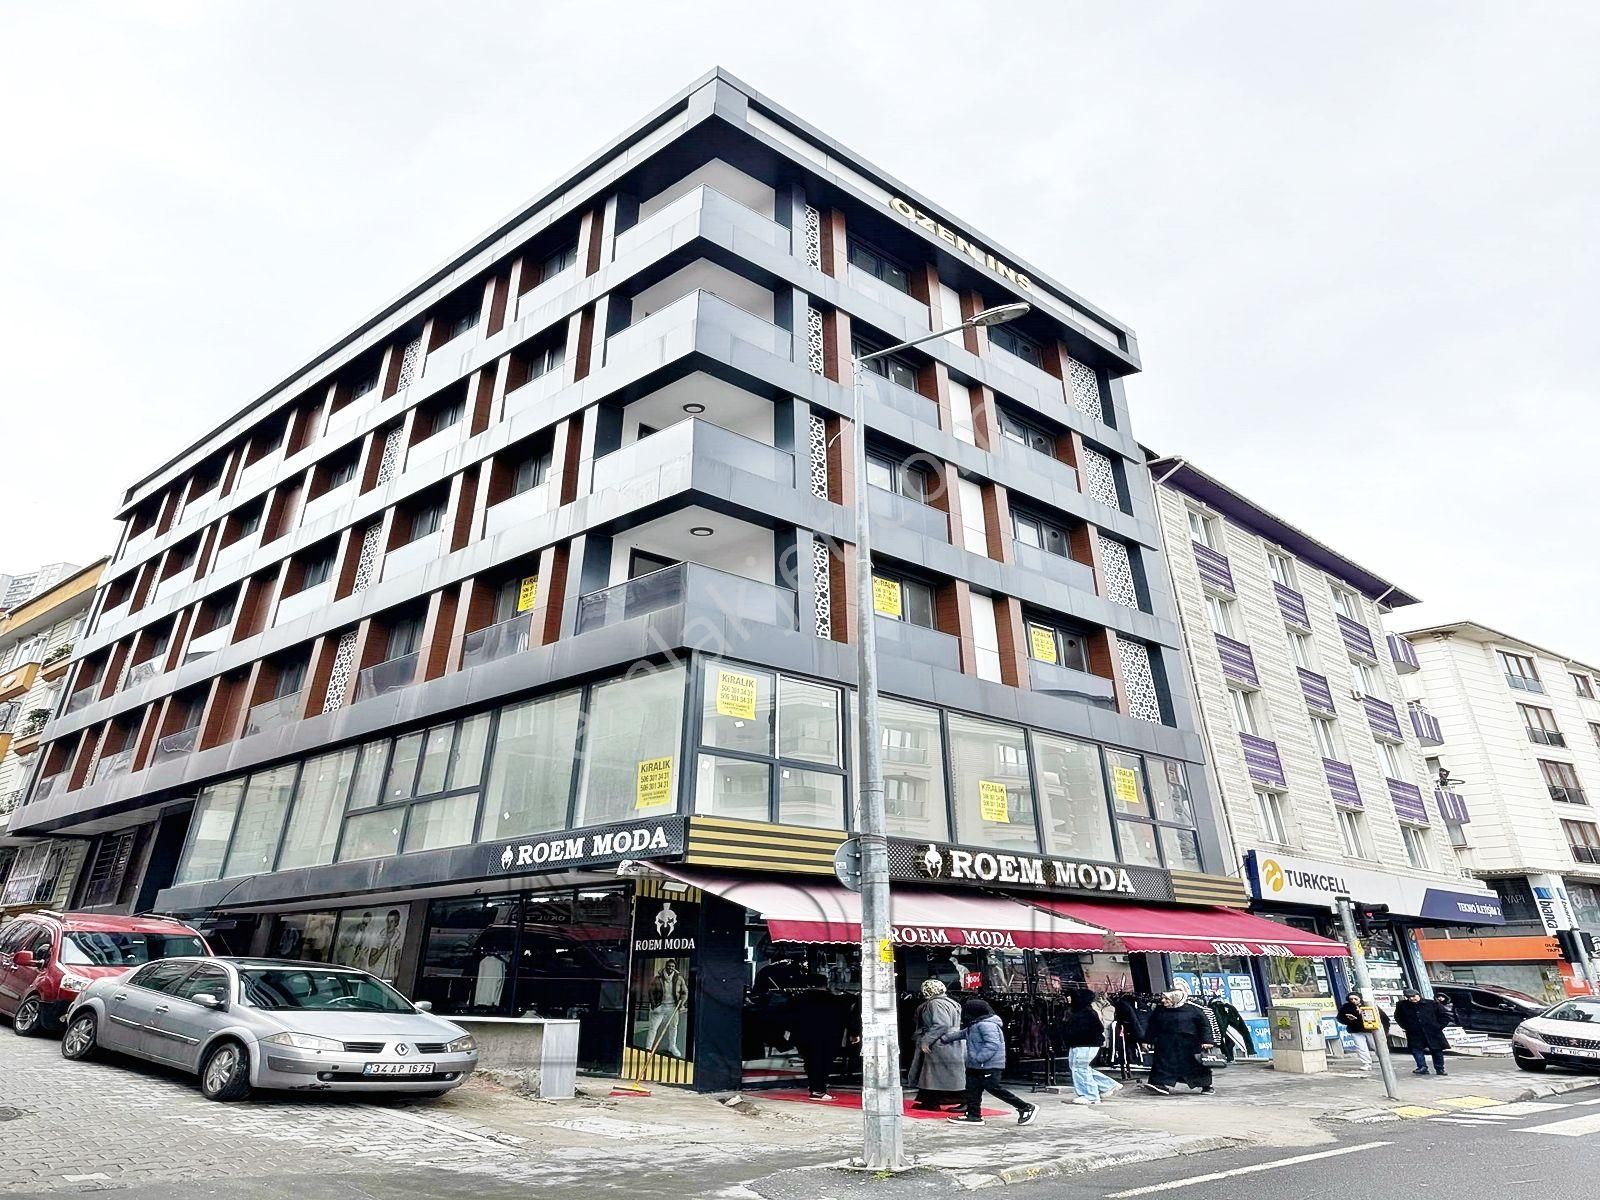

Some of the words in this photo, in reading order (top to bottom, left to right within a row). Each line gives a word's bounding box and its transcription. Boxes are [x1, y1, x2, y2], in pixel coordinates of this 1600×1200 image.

[516, 837, 586, 866] ROEM
[591, 826, 669, 857] MODA
[949, 849, 1047, 886] ROEM
[1052, 860, 1136, 894] MODA
[1284, 869, 1351, 895] TURKCELL
[635, 938, 663, 951] ROEM
[664, 937, 696, 950] MODA
[888, 927, 950, 944] ROEM
[961, 928, 1016, 948] MODA
[1210, 942, 1254, 957] ROEM
[373, 1064, 388, 1073] 34
[390, 1065, 405, 1073] AP
[408, 1064, 432, 1073] 1675
